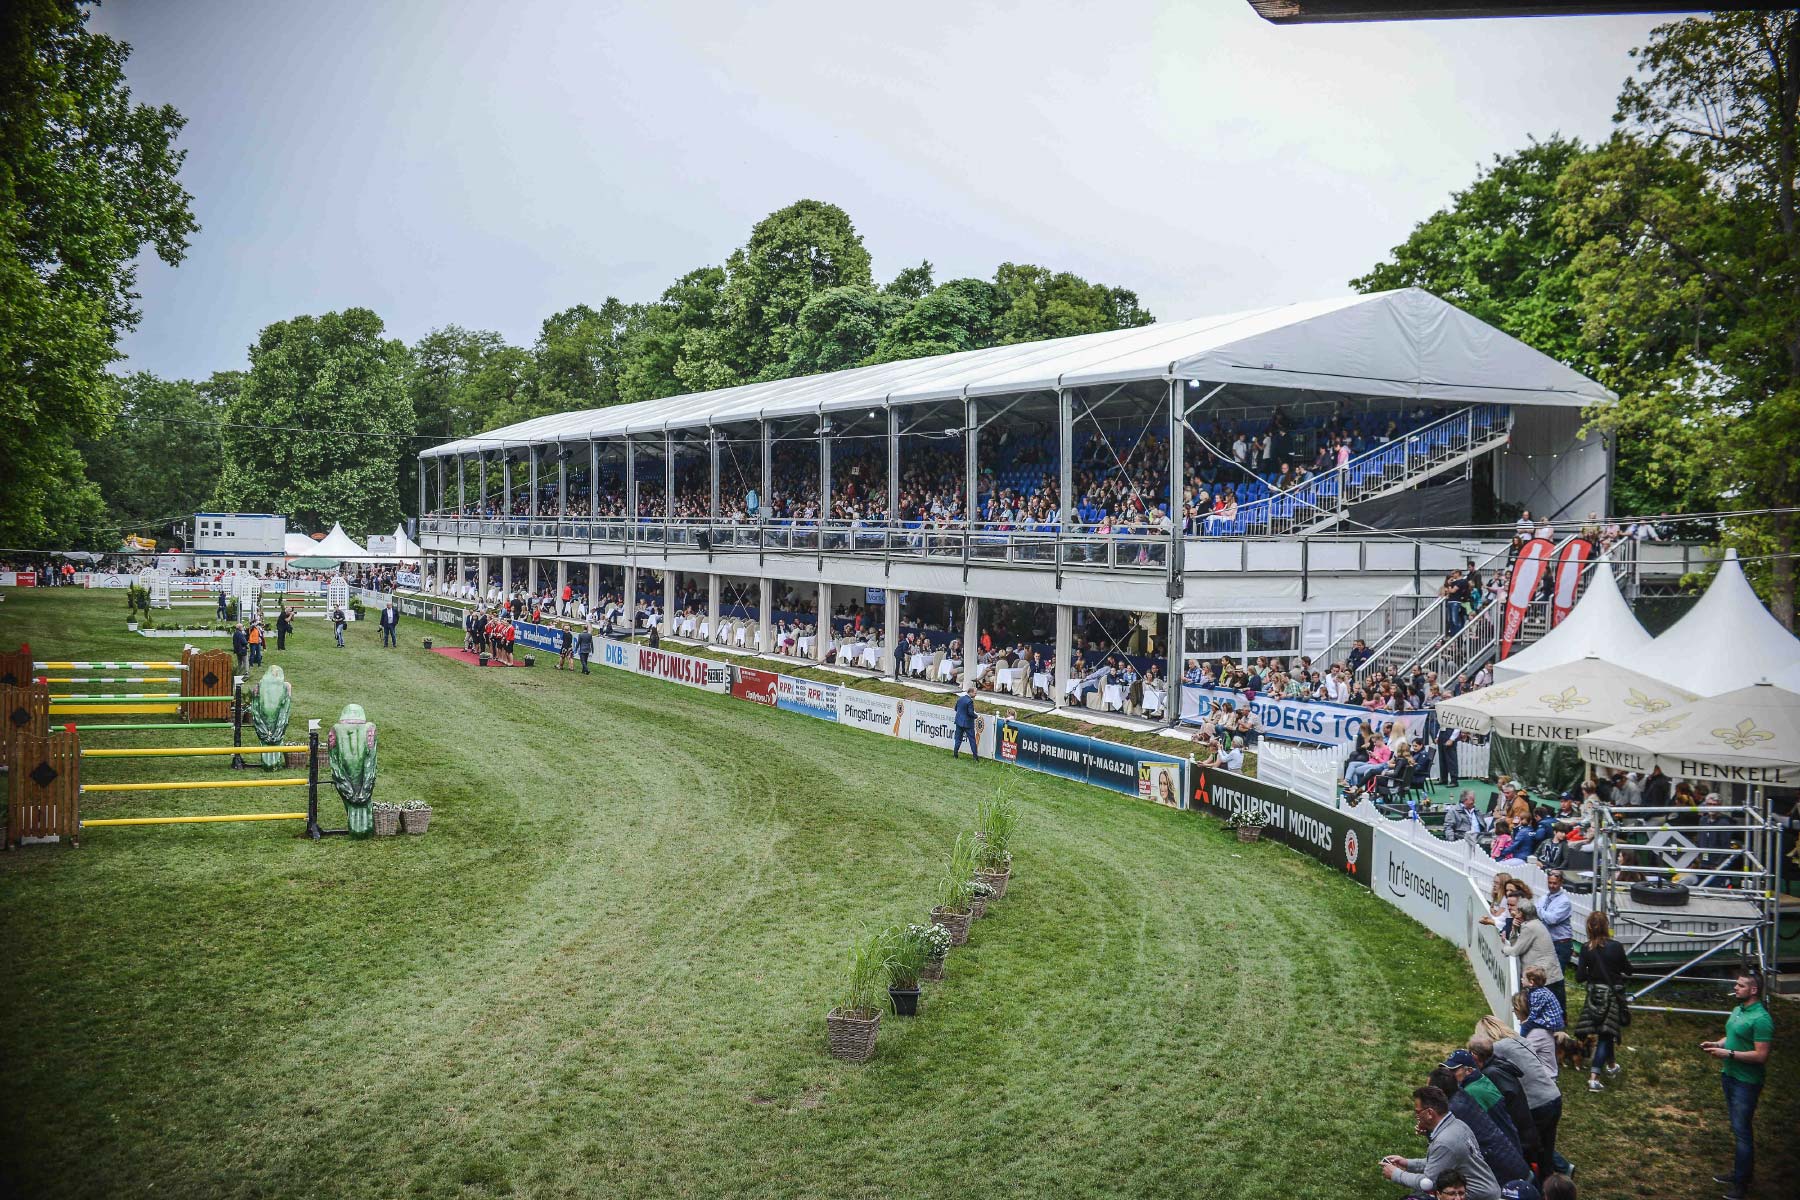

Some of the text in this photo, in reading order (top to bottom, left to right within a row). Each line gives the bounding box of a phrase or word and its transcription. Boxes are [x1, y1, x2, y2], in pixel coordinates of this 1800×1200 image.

[606, 643, 623, 665] DKB
[638, 649, 708, 686] NEPTUNUS.DE
[844, 704, 892, 726] PfingstTurnier
[1249, 701, 1324, 735] RIDERS
[1002, 723, 1019, 743] tv
[1511, 723, 1590, 740] HENKEL
[1022, 739, 1134, 777] DAS PREMIUM TV-MAGAZIN
[1588, 745, 1645, 770] HENKELL
[1680, 759, 1787, 784] HENKELL
[1212, 784, 1333, 852] MITSUBISHI MOTORS
